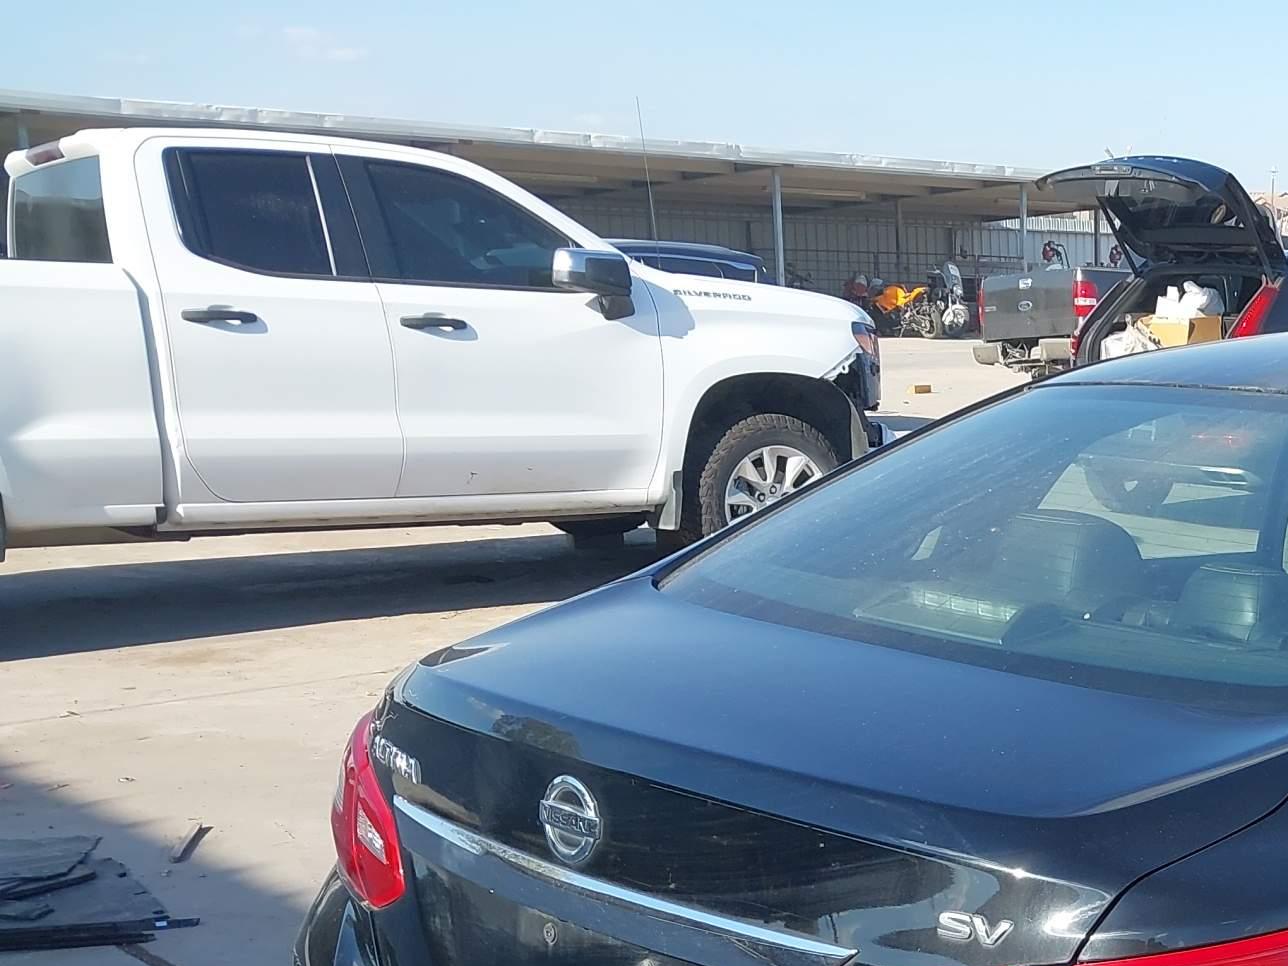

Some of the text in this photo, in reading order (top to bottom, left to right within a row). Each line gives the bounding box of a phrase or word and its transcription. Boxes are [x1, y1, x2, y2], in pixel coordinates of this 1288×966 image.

[673, 289, 752, 301] SILVERADO
[543, 804, 592, 834] NISSAN
[937, 911, 1015, 948] SV
